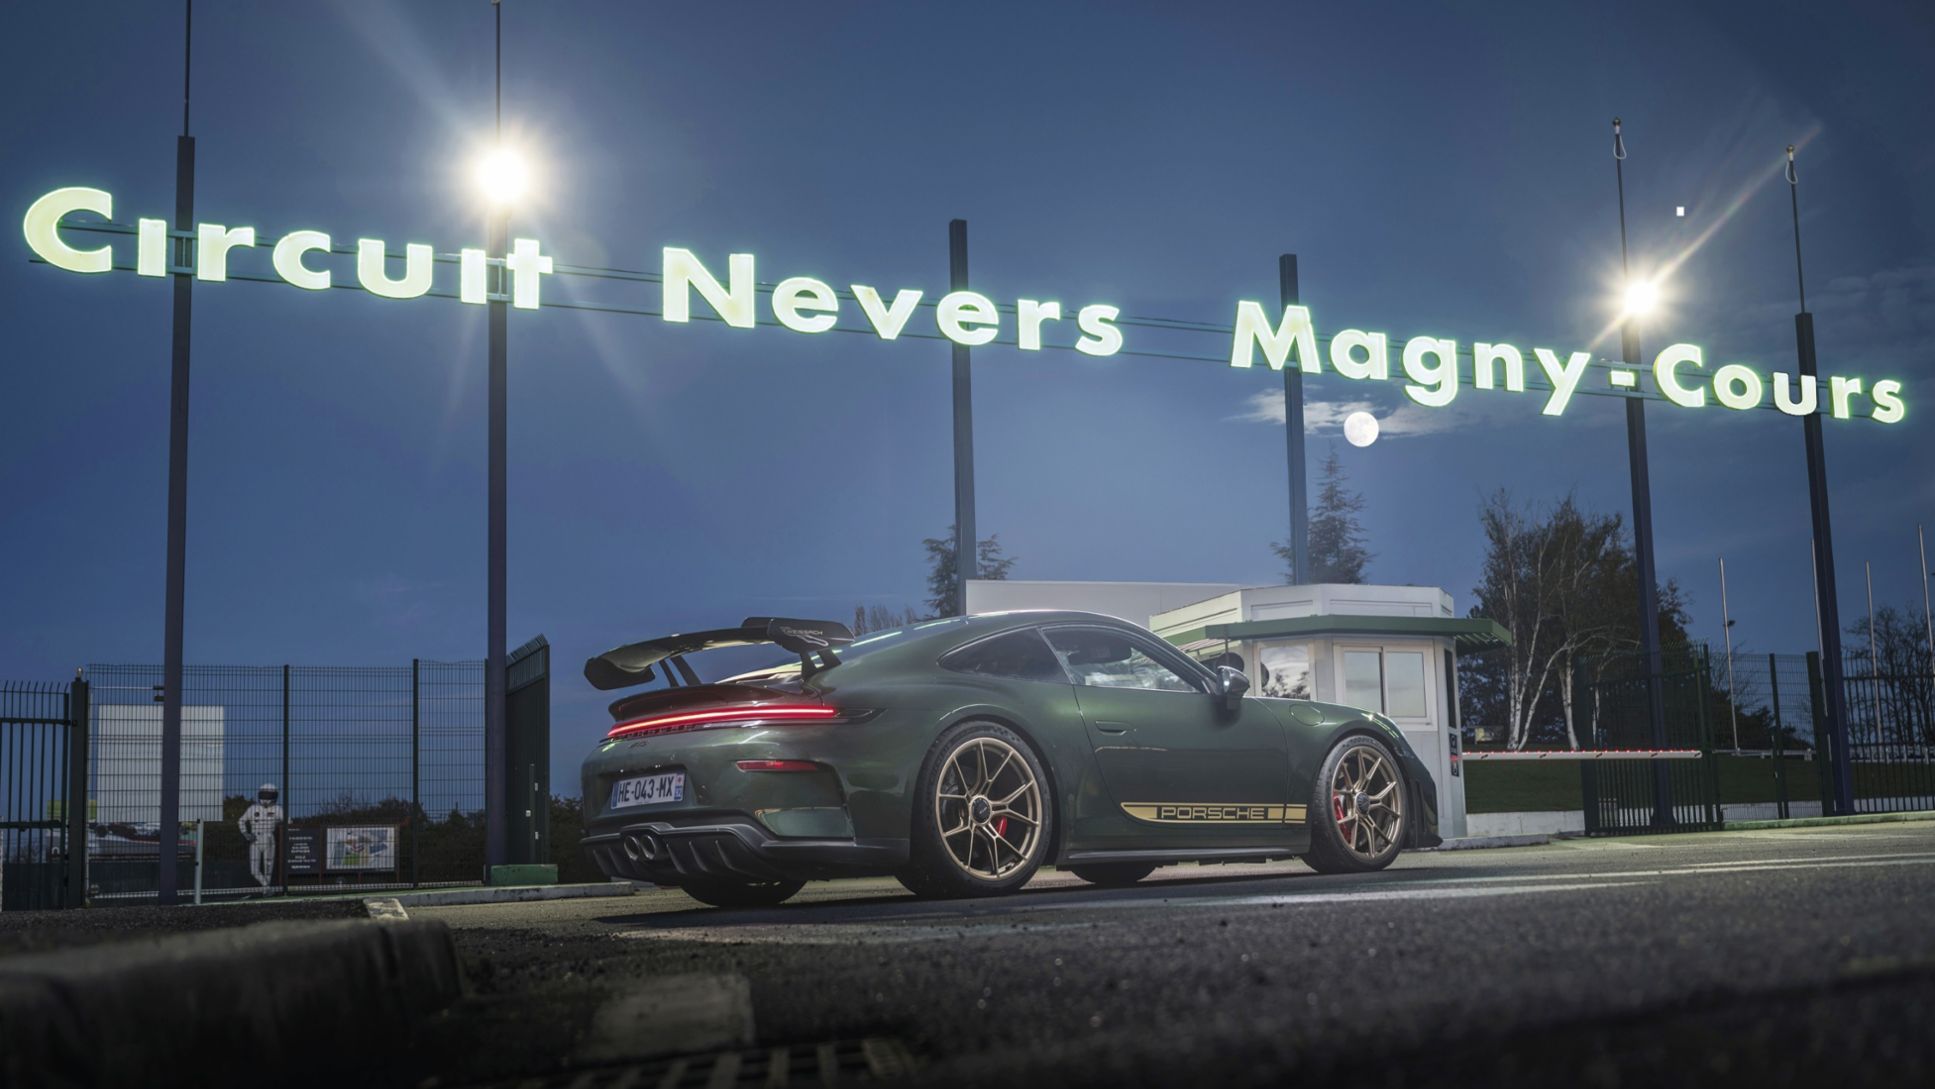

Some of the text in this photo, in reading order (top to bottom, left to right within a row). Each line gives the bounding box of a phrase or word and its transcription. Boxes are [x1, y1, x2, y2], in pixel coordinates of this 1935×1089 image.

[23, 186, 553, 310] Circuit
[662, 247, 1124, 357] Nevers
[1161, 806, 1266, 820] PORSCHE
